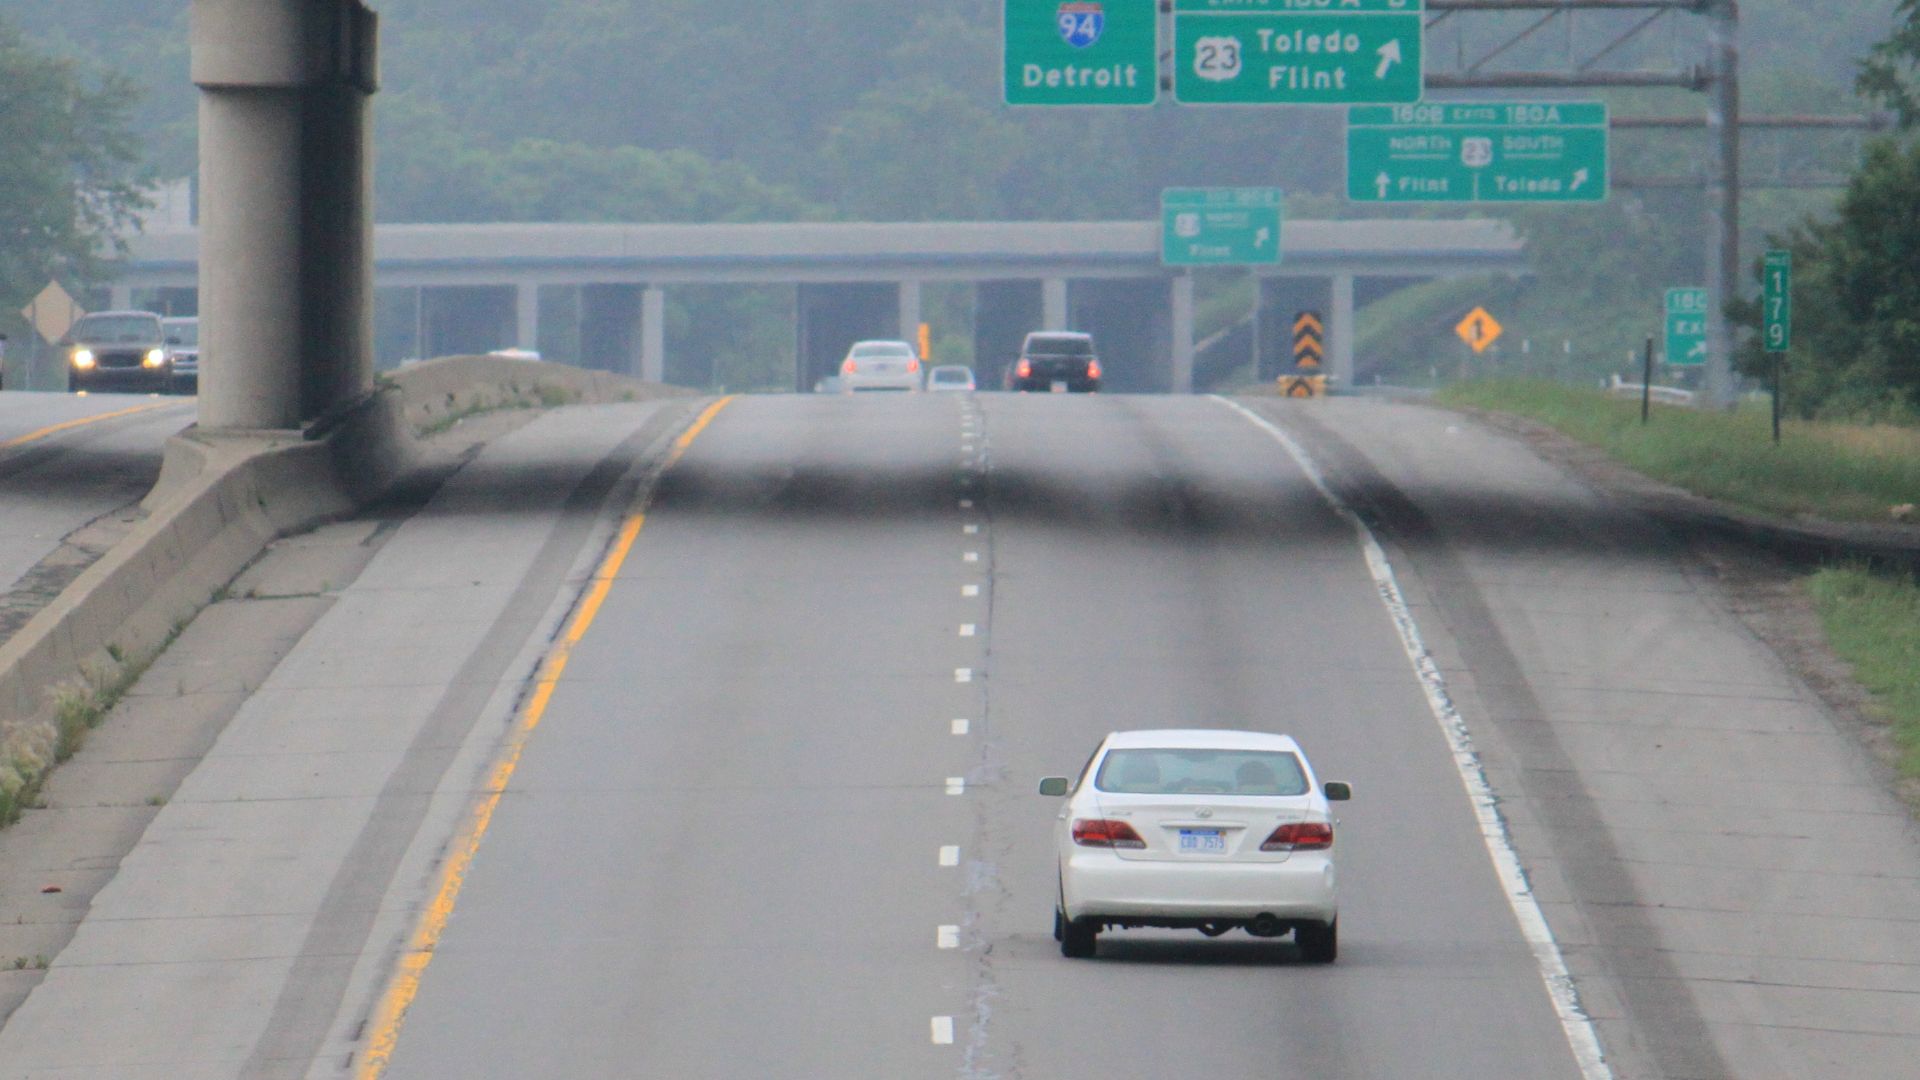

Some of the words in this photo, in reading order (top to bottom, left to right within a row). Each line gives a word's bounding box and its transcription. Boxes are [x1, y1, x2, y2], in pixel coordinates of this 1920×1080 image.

[1057, 13, 1096, 39] 94
[1257, 29, 1360, 53] Toledo
[1199, 45, 1237, 70] 23
[1022, 64, 1138, 88] Detroit
[1269, 66, 1347, 90] Flint
[1398, 177, 1449, 192] Flint
[1495, 175, 1562, 193] Toledo
